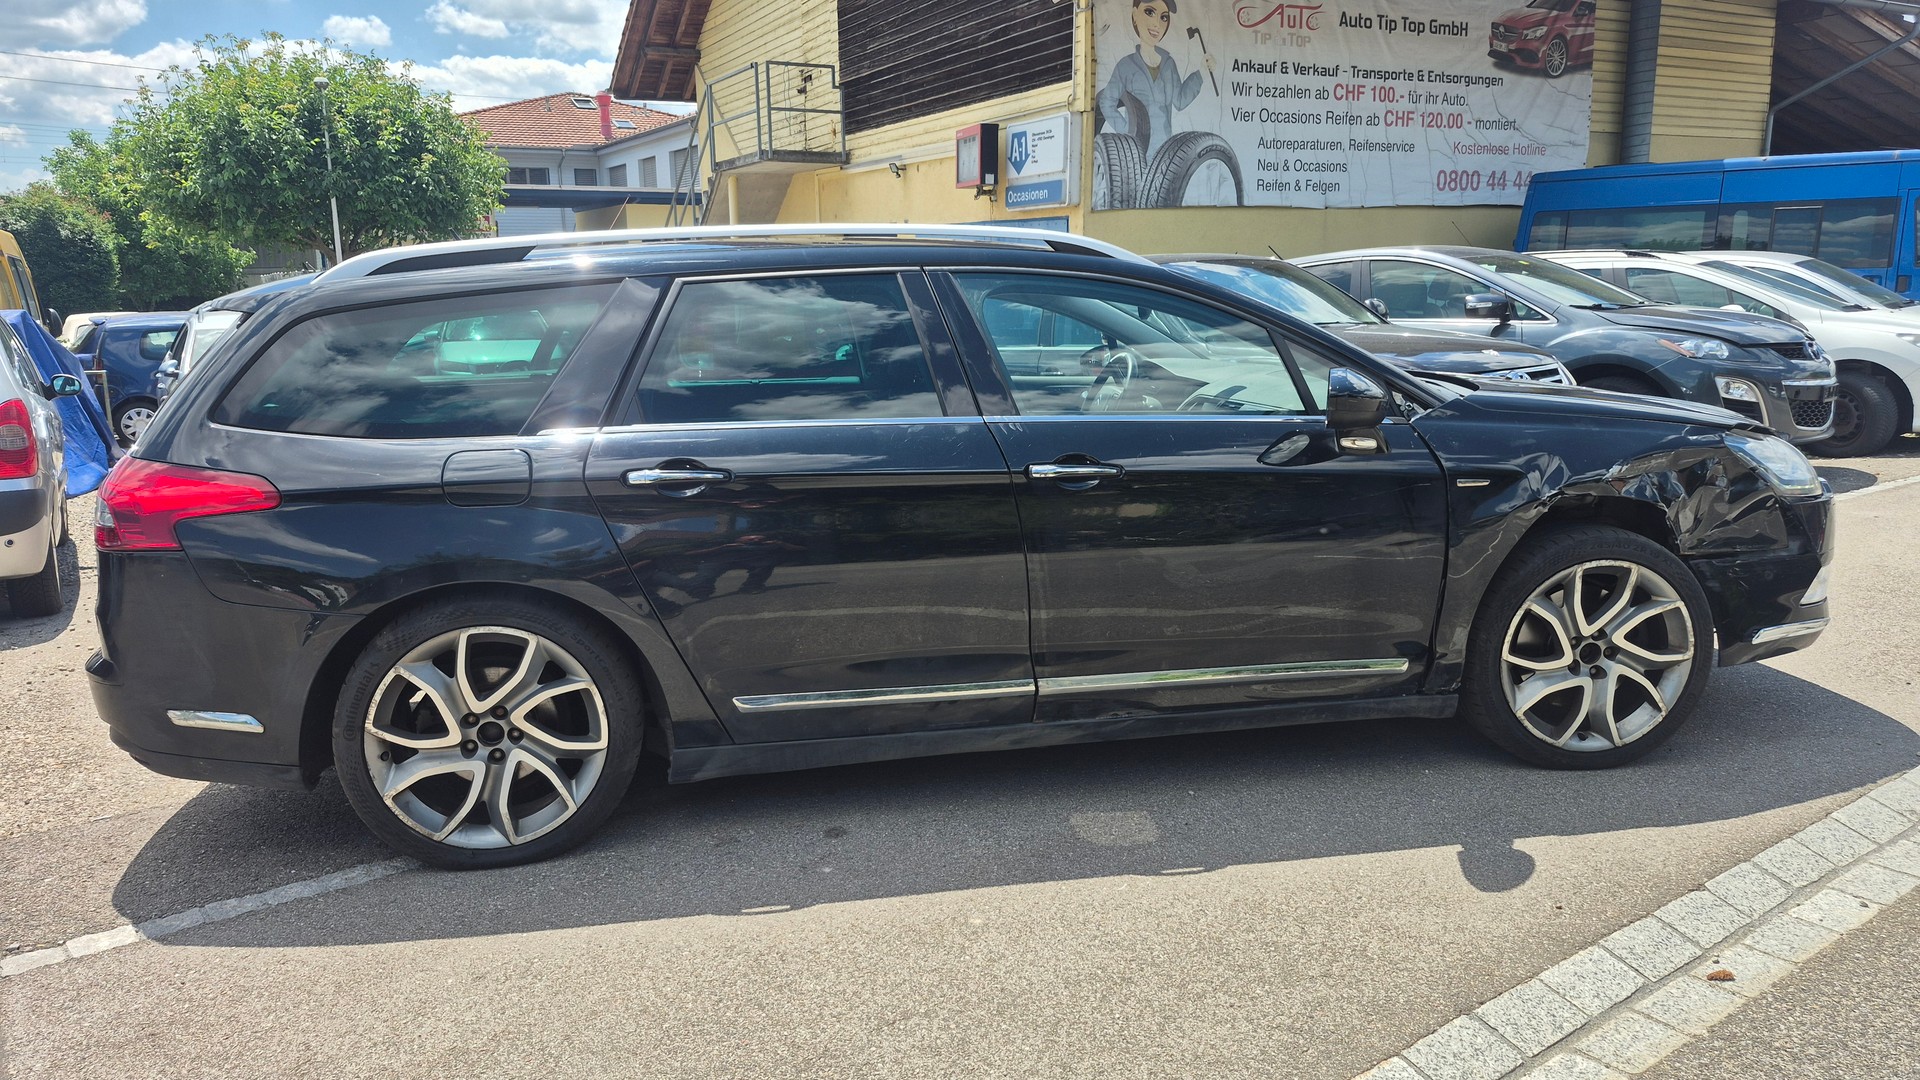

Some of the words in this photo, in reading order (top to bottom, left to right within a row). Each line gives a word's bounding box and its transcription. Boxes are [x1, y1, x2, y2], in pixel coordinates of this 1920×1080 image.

[1339, 11, 1373, 29] Auto
[1377, 14, 1398, 34] Tip
[1401, 17, 1426, 36] Top
[1429, 19, 1469, 37] GmbH
[1232, 58, 1278, 74] Ankauf
[1280, 61, 1289, 75] &
[1292, 62, 1340, 78] Verkauf
[1351, 65, 1415, 82] Transporte
[1417, 69, 1425, 82] &
[1427, 70, 1504, 88] Entsorgungen
[1232, 82, 1253, 97] Wir
[1256, 83, 1311, 99] bezahlen
[1315, 86, 1330, 100] ab
[1333, 83, 1366, 101] CHF
[1370, 85, 1405, 103] 100.-
[1408, 90, 1422, 104] für
[1425, 91, 1440, 105] ihr
[1441, 92, 1469, 107] Auto.
[1231, 107, 1256, 122] Vier
[1259, 108, 1322, 125] Occasions
[1325, 111, 1363, 126] Reifen
[1366, 113, 1380, 127] ab
[1384, 110, 1415, 128] CHF
[1419, 112, 1464, 129] 120.00
[1257, 136, 1345, 153] Autoreparaturen,
[1349, 138, 1415, 153] Reifenservice
[1453, 142, 1509, 156] Kostenlose
[1513, 143, 1547, 156] Hotline
[1257, 159, 1279, 172] Neu
[1282, 160, 1290, 172] &
[1293, 159, 1348, 173] Occasions
[1256, 179, 1291, 192] Reifen
[1294, 180, 1302, 192] &
[1305, 179, 1341, 195] Felgen
[1436, 169, 1481, 192] 0800
[1486, 170, 1508, 191] 44
[1007, 189, 1049, 203] Occasionen
